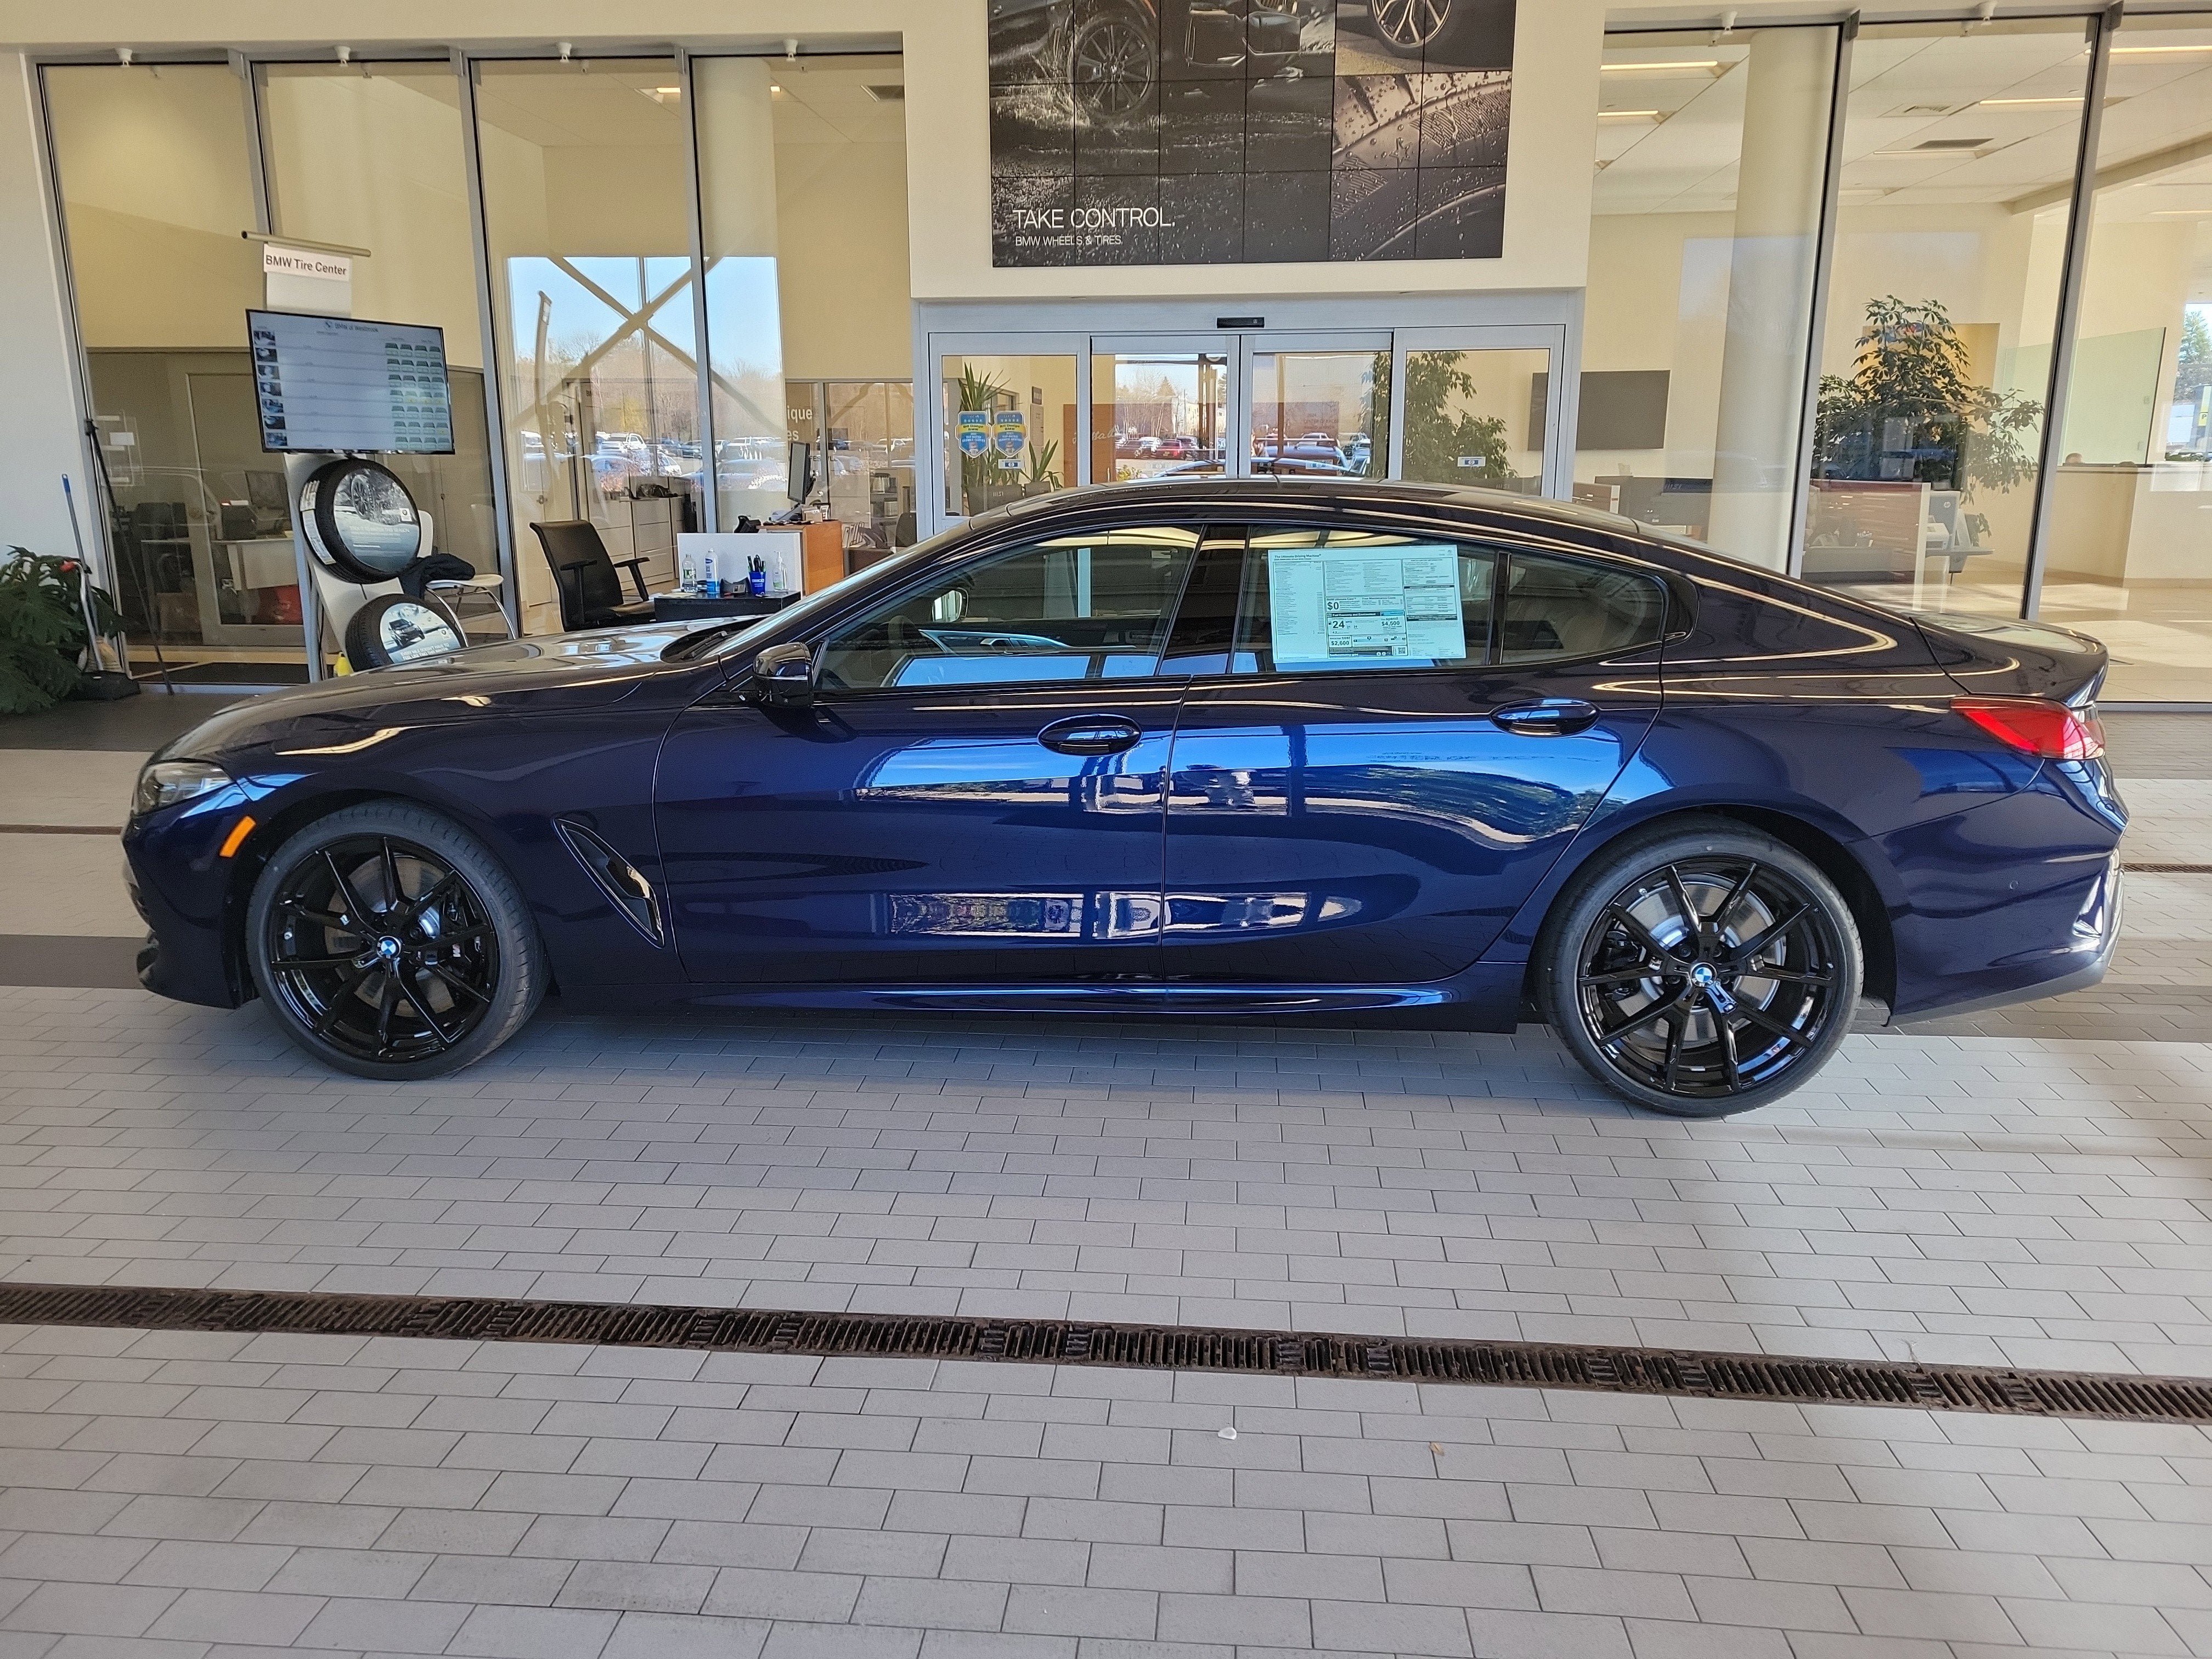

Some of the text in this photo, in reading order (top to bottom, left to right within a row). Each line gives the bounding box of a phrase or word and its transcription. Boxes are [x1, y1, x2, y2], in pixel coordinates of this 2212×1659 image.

[1013, 207, 1175, 229] TAKE CONTROL.
[1015, 235, 1123, 246] BMW WHEELS & TIRES.
[266, 255, 347, 275] BMW Tire Center
[787, 405, 812, 423] ique
[1327, 601, 1339, 611] $0
[1332, 620, 1345, 629] 24
